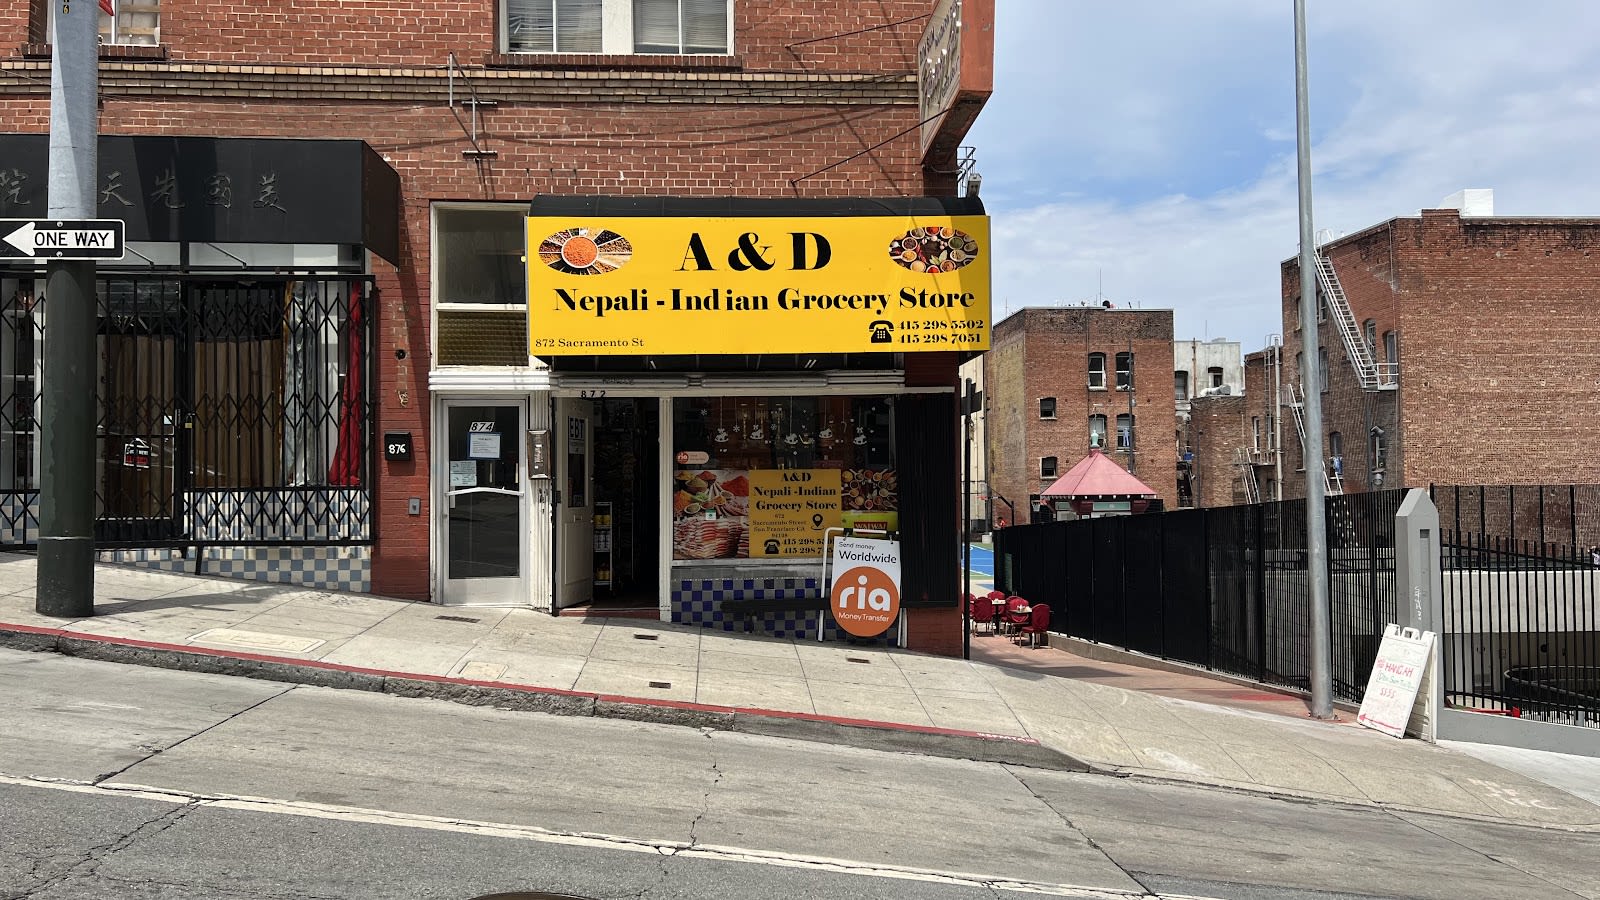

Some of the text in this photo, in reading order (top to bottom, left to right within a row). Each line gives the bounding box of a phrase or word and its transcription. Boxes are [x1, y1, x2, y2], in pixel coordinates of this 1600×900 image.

[35, 232, 109, 247] ONE WAY
[553, 288, 649, 317] Nepali
[777, 287, 891, 316] Grocery
[899, 287, 975, 309] Store
[897, 320, 984, 330] 415 298 5502
[535, 337, 645, 348] 872 Sacramento St
[898, 334, 982, 345] 415 298 7051
[581, 390, 606, 398] 872
[471, 422, 494, 432] 874
[570, 418, 585, 438] EBT
[388, 444, 406, 454] 876
[754, 486, 791, 498] Nepali
[756, 500, 838, 512] Grocery Store
[838, 541, 876, 552] Send money
[838, 550, 897, 564] Worldwide
[839, 575, 891, 612] ria
[838, 611, 889, 623] Money Transfer
